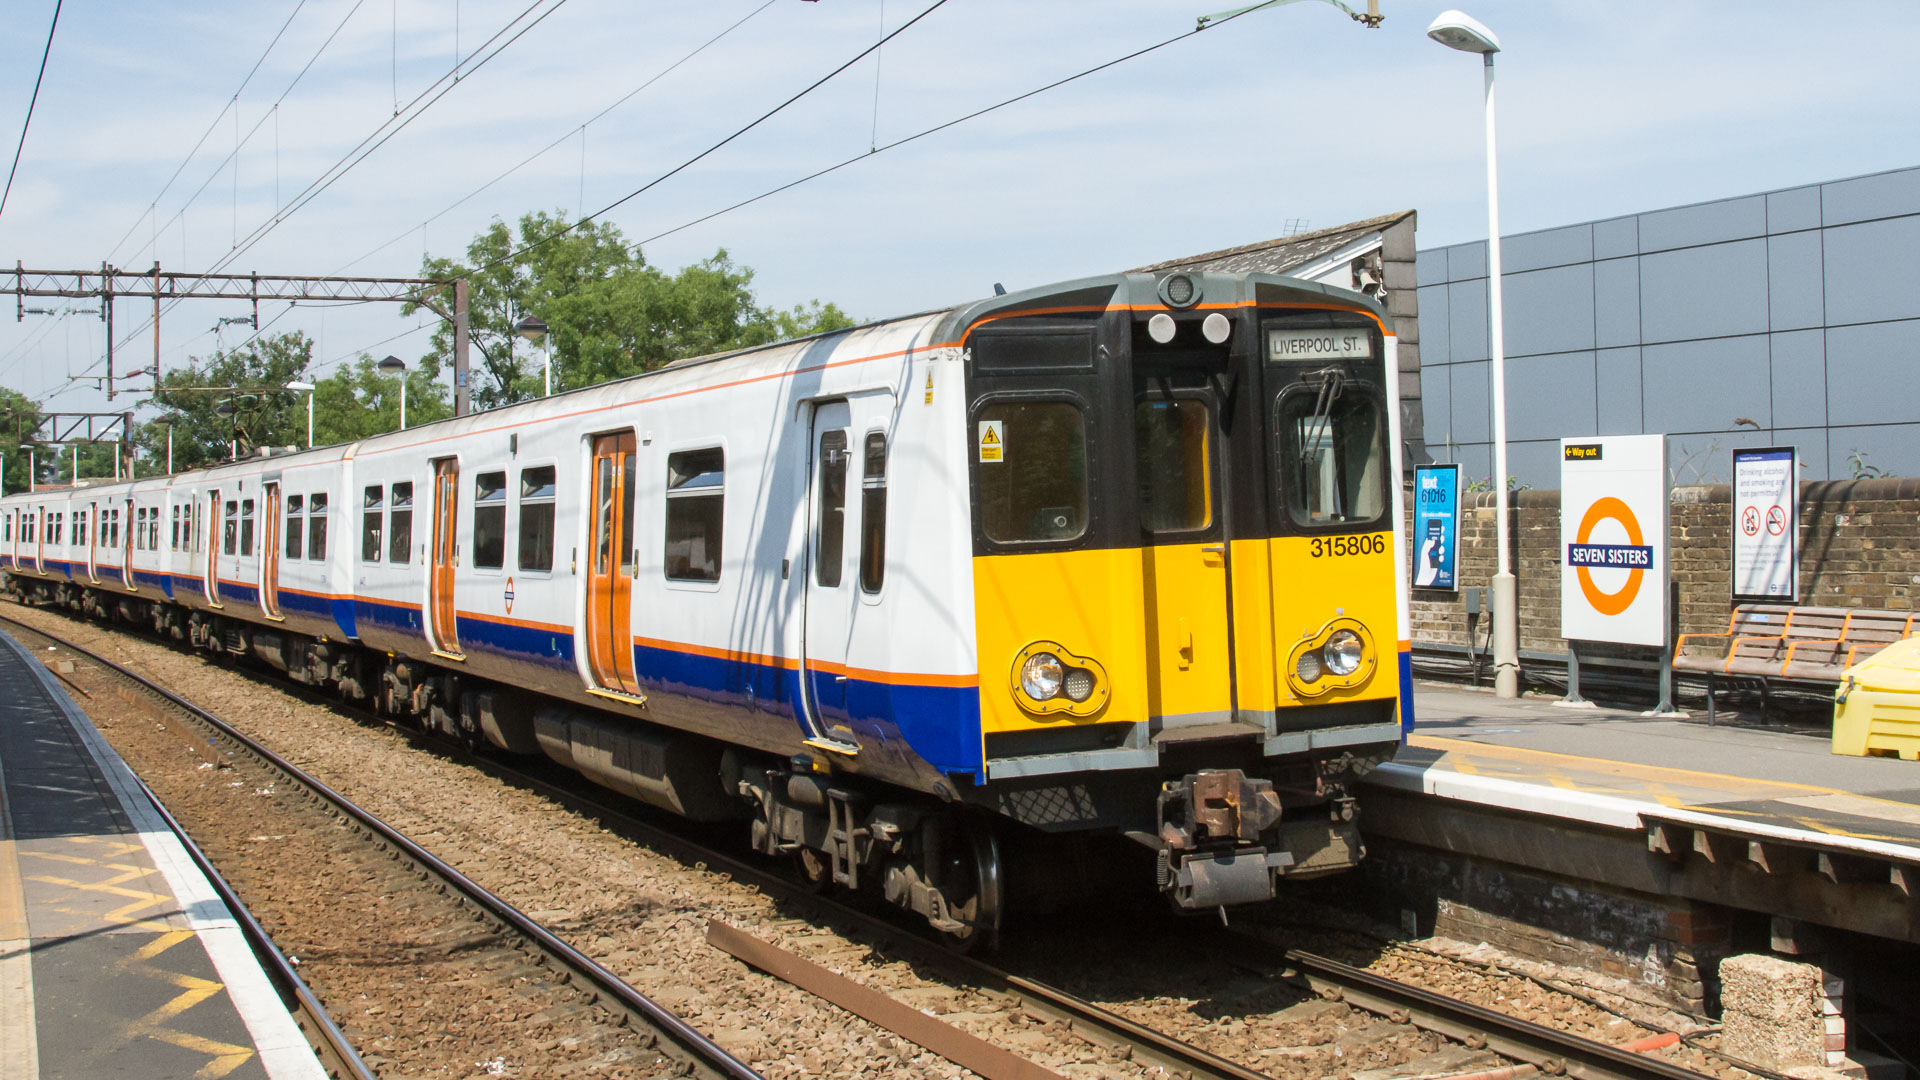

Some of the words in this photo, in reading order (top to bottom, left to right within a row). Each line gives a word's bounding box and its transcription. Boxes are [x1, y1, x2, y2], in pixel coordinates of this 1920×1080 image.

[1274, 337, 1339, 354] LIVERPOOL
[1343, 336, 1361, 351] ST.
[1571, 447, 1585, 458] Way
[1585, 447, 1597, 456] out
[1740, 468, 1762, 477] Drinking
[1764, 467, 1784, 475] alcohol
[1422, 476, 1438, 489] text
[1751, 479, 1774, 487] smoking
[1421, 488, 1446, 503] 61016
[1751, 490, 1778, 498] permitted
[1311, 534, 1385, 558] 315806
[1572, 547, 1605, 563] SEVEN
[1608, 548, 1648, 565] SISTERS
